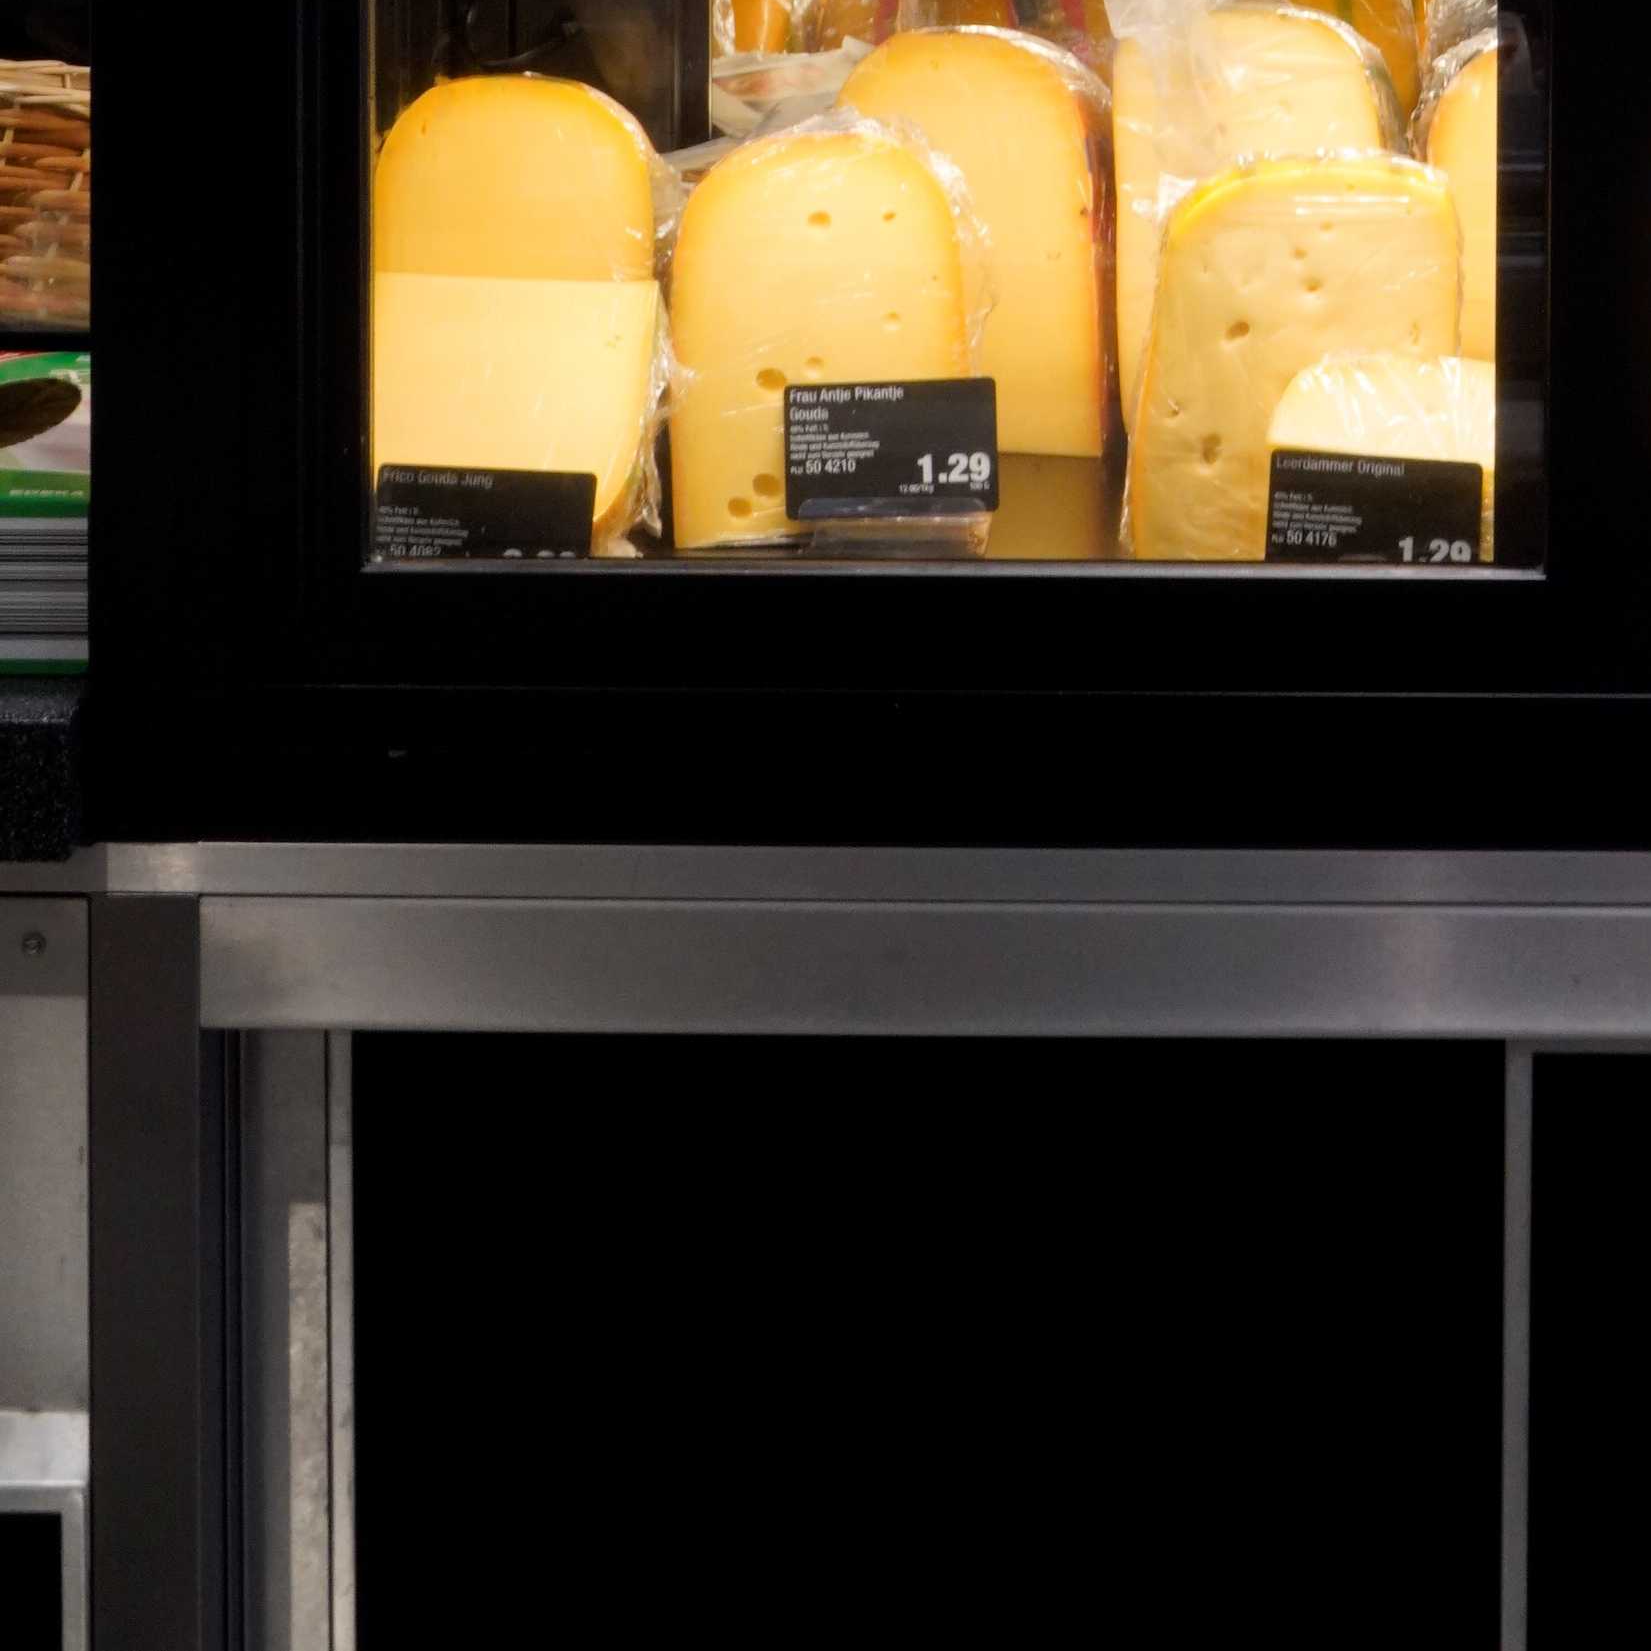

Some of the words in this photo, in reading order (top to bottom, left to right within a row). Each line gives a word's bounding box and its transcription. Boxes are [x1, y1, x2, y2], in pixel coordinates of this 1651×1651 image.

[790, 390, 816, 403] Frau
[820, 387, 851, 403] Antje
[855, 386, 904, 401] Pikantje
[790, 407, 829, 421] Gouda
[806, 459, 821, 474] 50
[825, 458, 856, 473] 4210
[917, 452, 991, 484] 1.29
[1277, 458, 1353, 471] Leerdammer
[1358, 460, 1404, 476] Original
[383, 469, 415, 483] Frico
[418, 471, 458, 485] Gouda
[461, 473, 494, 489] Jung
[1287, 531, 1301, 543] 50
[1306, 531, 1337, 547] 4176
[1399, 536, 1472, 563] 1.29
